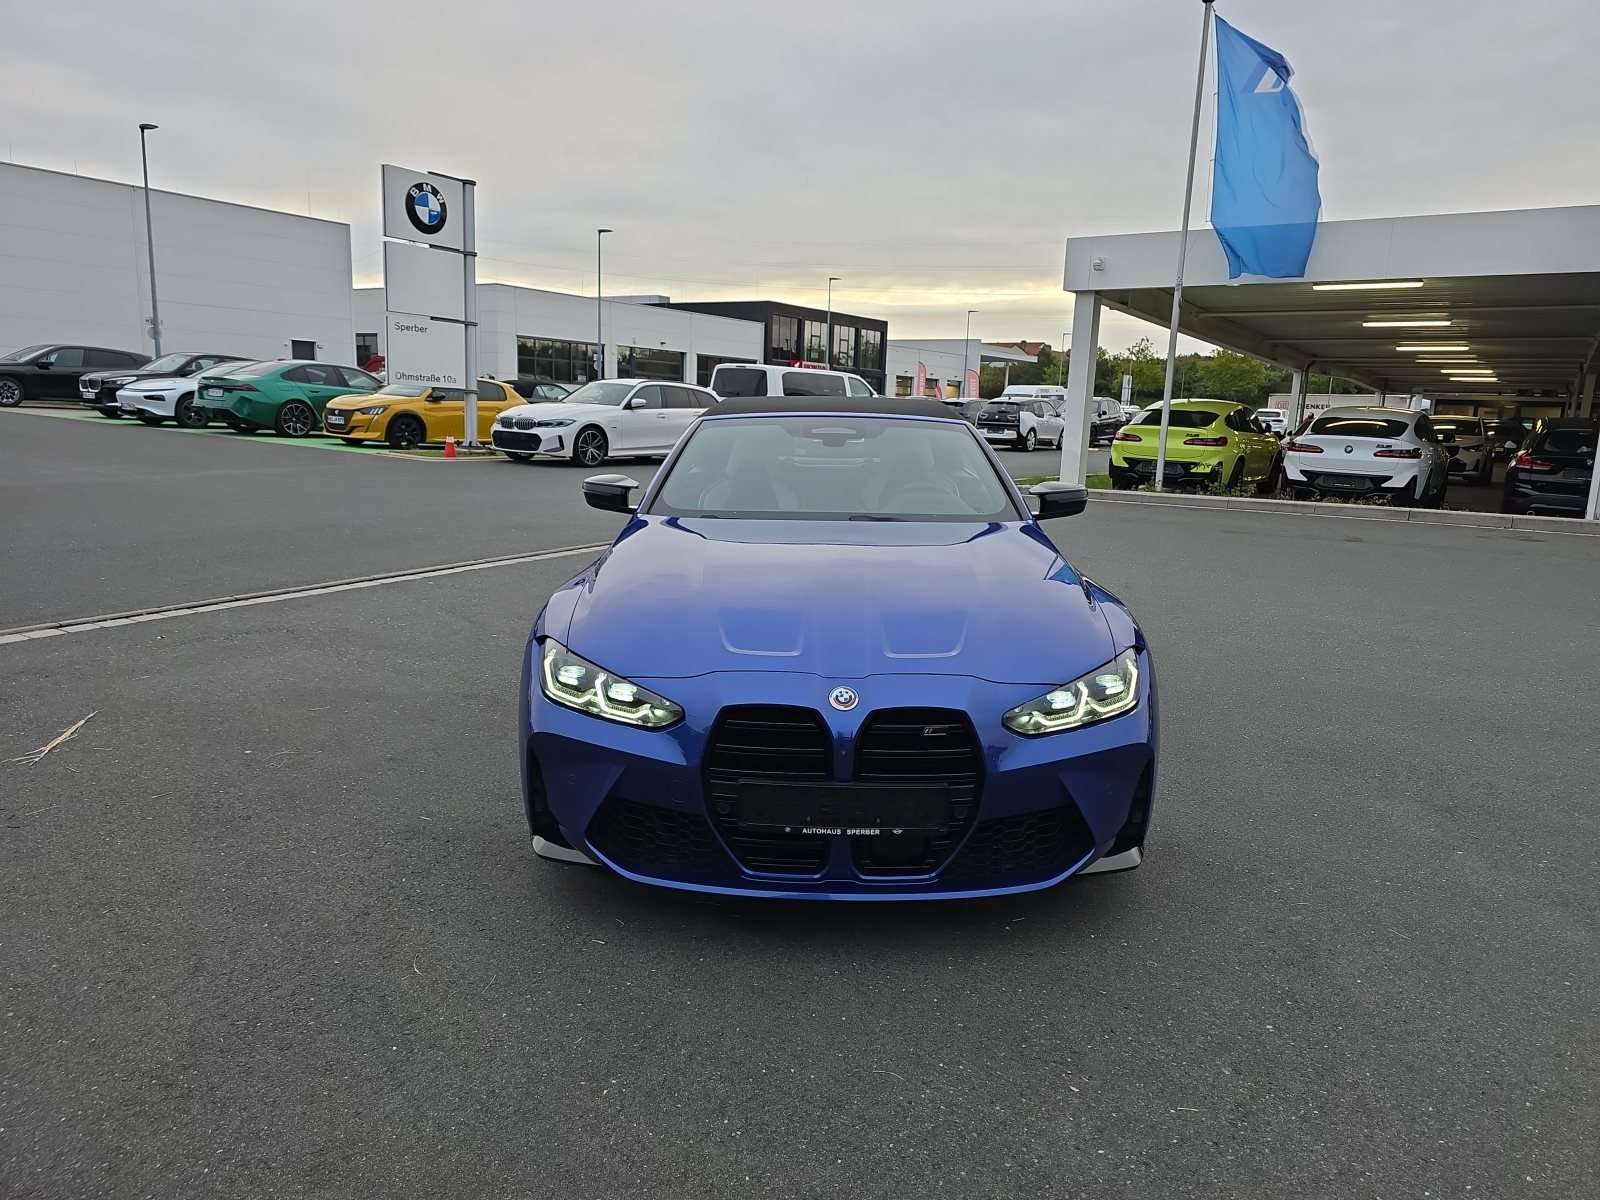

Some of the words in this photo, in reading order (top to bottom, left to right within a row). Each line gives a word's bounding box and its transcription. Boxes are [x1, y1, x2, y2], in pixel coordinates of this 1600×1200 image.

[409, 183, 445, 204] BMW
[394, 321, 428, 334] Sperber
[395, 371, 441, 383] Ohmstraße
[442, 375, 457, 384] 10a
[802, 827, 842, 835] AUTOHAUS
[846, 828, 880, 836] SPERBER
